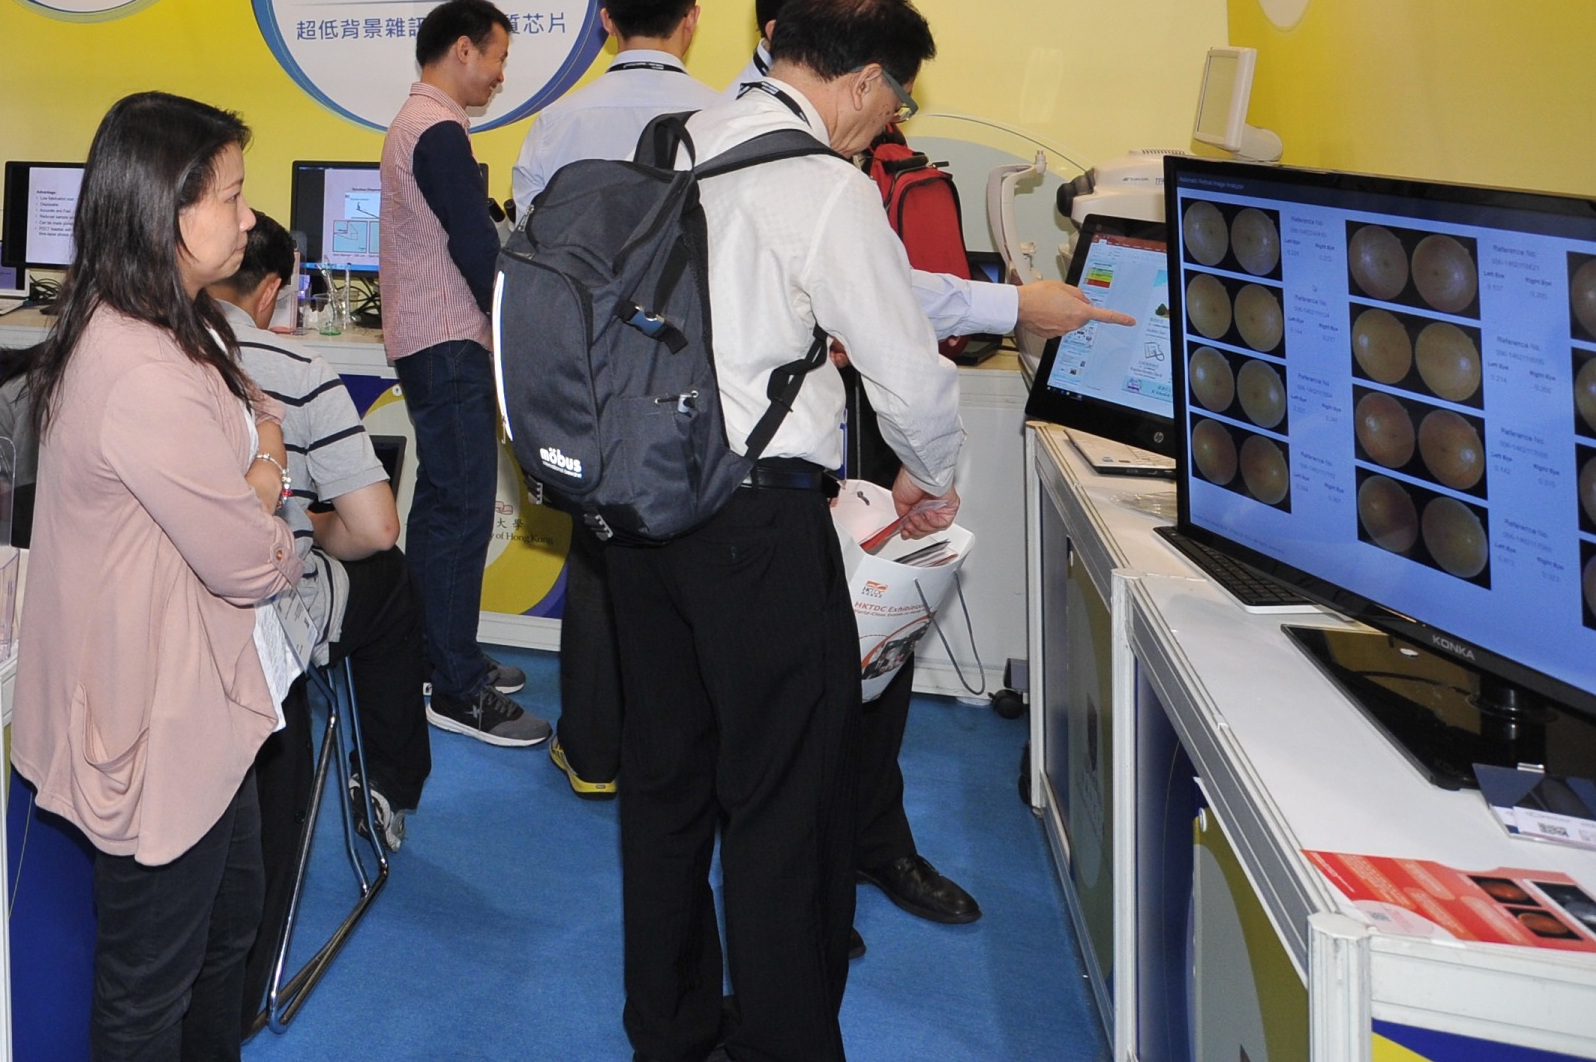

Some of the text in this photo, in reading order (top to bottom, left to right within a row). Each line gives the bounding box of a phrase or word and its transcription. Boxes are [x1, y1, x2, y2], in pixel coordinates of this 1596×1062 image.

[297, 12, 567, 41] 超低背景雜訊質芯片
[540, 447, 582, 473] möbus
[855, 602, 887, 612] HKTDC
[1432, 634, 1476, 661] KONKA
